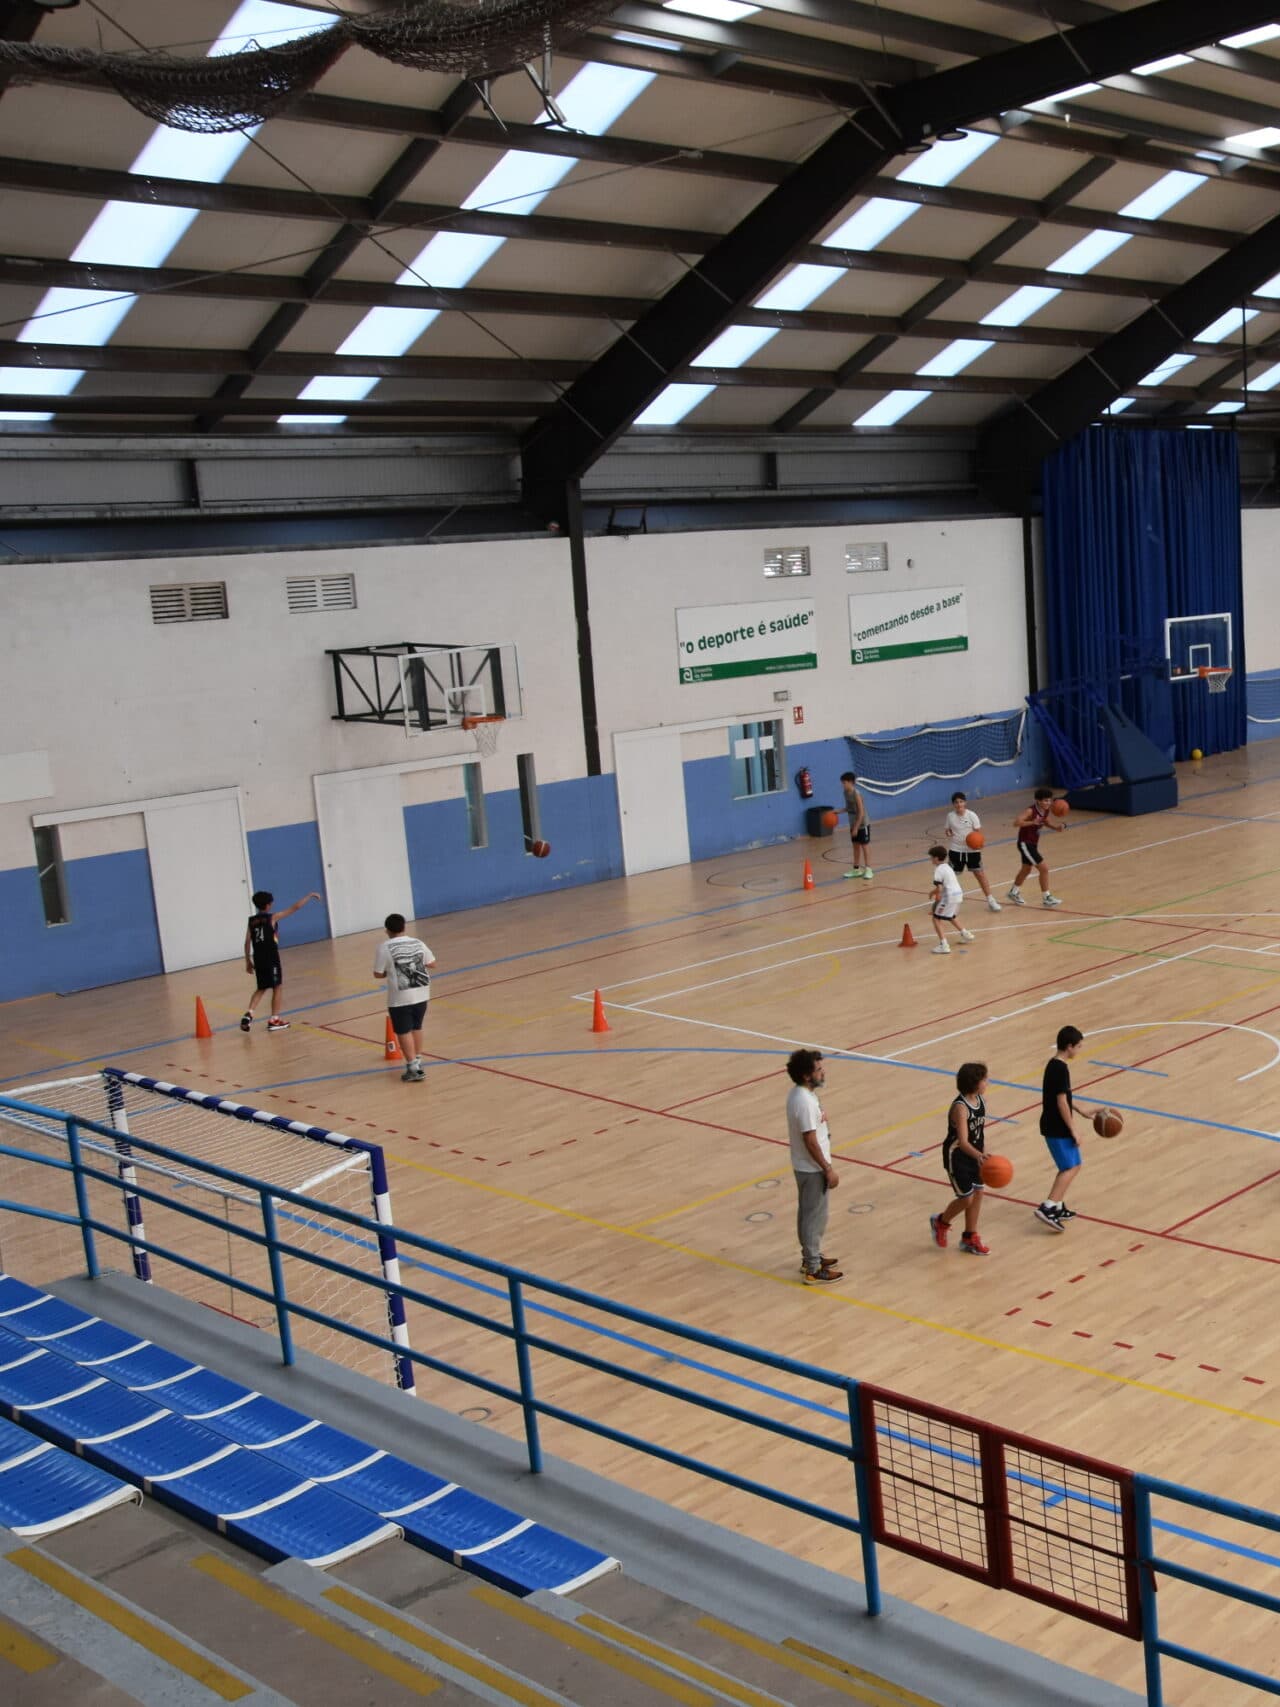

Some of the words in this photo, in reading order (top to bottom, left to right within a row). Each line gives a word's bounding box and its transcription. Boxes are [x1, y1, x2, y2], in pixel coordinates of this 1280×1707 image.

[910, 604, 934, 621] desde
[936, 601, 942, 612] a
[698, 625, 755, 650] deporte
[758, 620, 766, 635] é
[769, 610, 814, 633] saúde"
